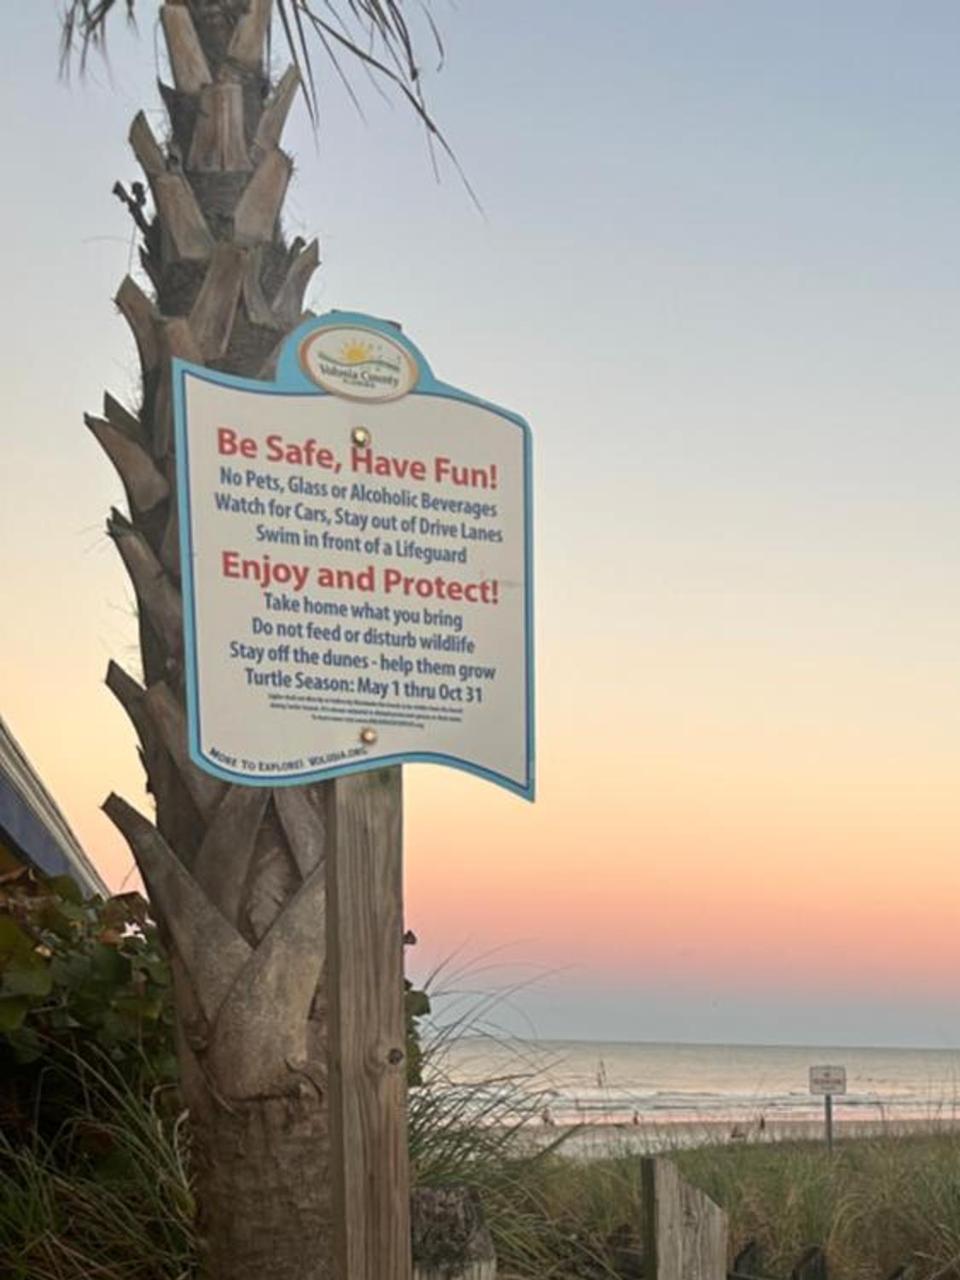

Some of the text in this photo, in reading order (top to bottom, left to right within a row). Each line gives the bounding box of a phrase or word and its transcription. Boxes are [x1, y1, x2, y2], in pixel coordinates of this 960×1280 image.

[218, 428, 497, 490] Be Safe, Have Fun!
[220, 466, 498, 520] No Pets, Glass or Alcoholic Beverages
[214, 492, 503, 542] Watch for Cars, Stay out of Drive Lanes
[256, 527, 467, 565] Swim in front of a Lifeguard
[222, 550, 498, 605] Enjoy and Protect!
[264, 592, 463, 632] Take home what you bring
[252, 616, 476, 654] Do not feed or disturb wildlife
[230, 640, 265, 664] Stay
[267, 644, 290, 663] off
[293, 646, 320, 666] the
[322, 649, 369, 669] dunes
[380, 654, 414, 676] help
[416, 658, 456, 676] them
[458, 664, 496, 682] grow
[244, 667, 482, 703] Turtle Season: May 1 thru Oct 31
[242, 759, 256, 769] TO
